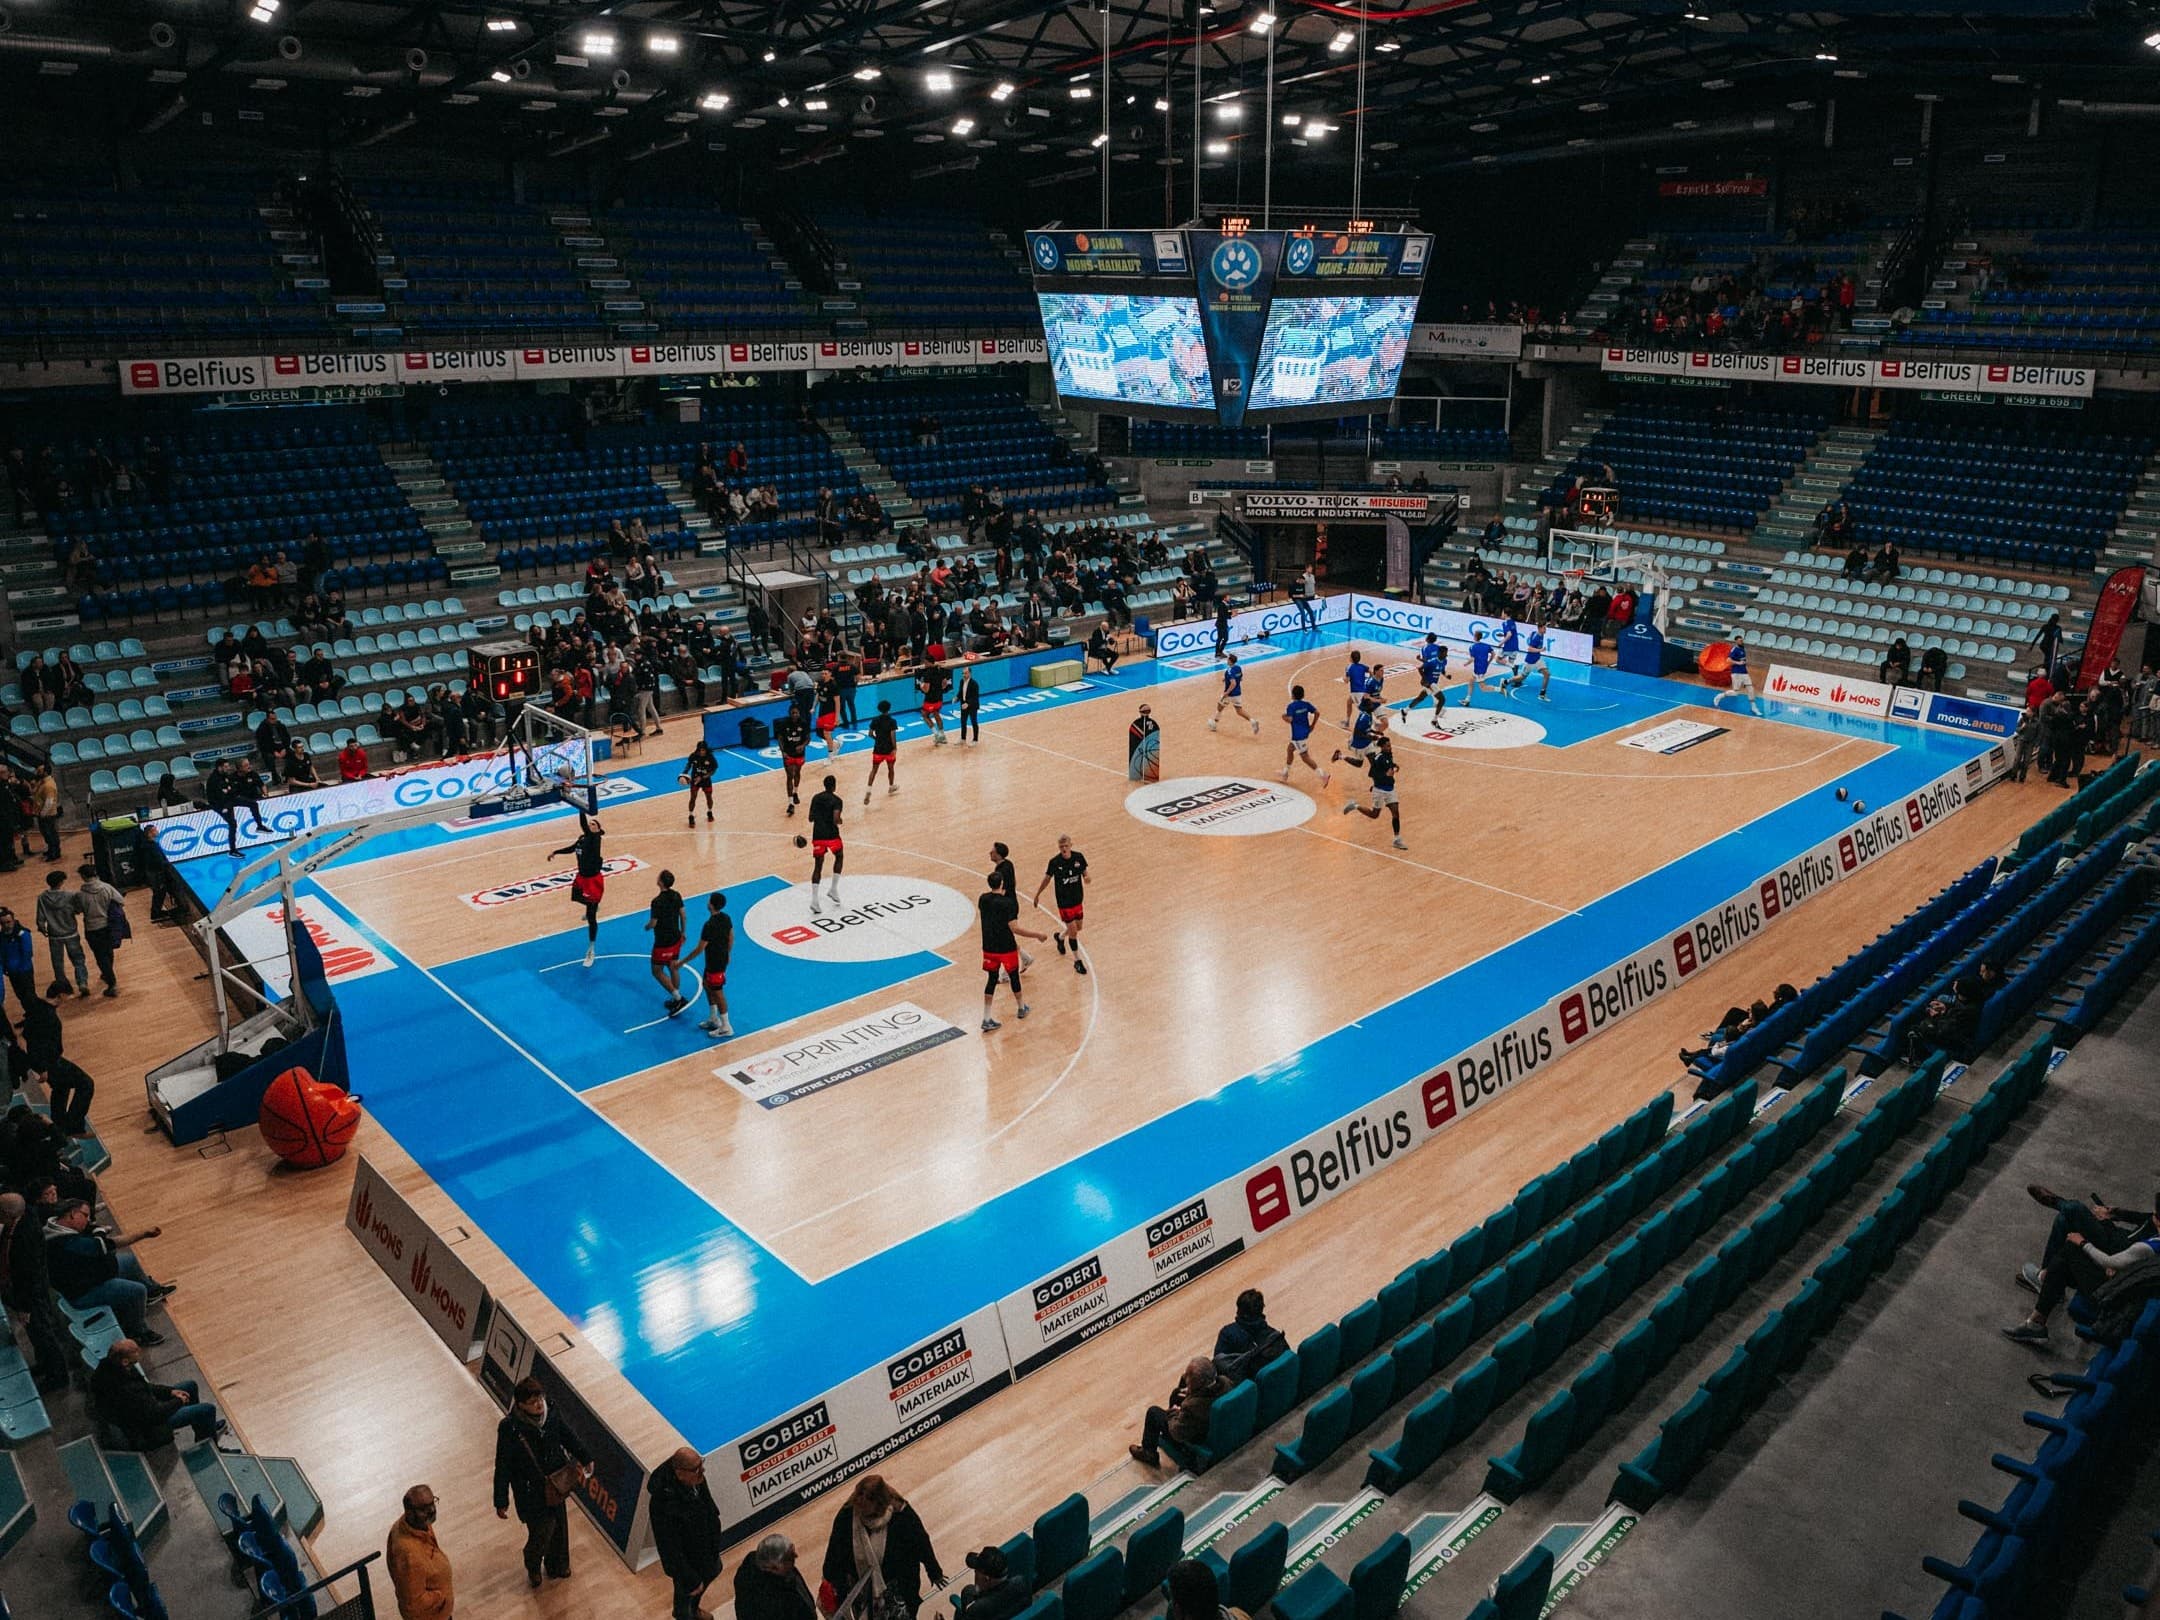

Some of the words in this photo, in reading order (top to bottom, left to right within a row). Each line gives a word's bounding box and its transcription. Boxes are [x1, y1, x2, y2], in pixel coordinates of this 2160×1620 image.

[1090, 237, 1124, 250] UNION
[1350, 240, 1380, 253] UNION
[654, 346, 716, 363] Belfius
[751, 344, 808, 362] Belfius
[922, 340, 971, 355] Belfius
[998, 339, 1043, 353] Belfius
[1711, 353, 1769, 370] Belfius
[164, 361, 255, 387] Belfius
[304, 354, 386, 374] Belfius
[1804, 358, 1866, 377] Belfius
[1904, 361, 1972, 380] Belfius
[2012, 365, 2086, 386] Belfius
[249, 389, 300, 401] GREEN
[1941, 391, 1981, 402] GREEN
[1191, 493, 1199, 502] B
[1250, 496, 1307, 507] VOLVO
[1318, 496, 1359, 507] TRUCK
[1369, 497, 1427, 509] MITSUBISHI
[1459, 494, 1468, 506] C
[1246, 509, 1277, 517] MONS
[1280, 509, 1315, 518] TRUCK
[1318, 509, 1371, 519] INDUSTRY
[1355, 600, 1433, 630] Gocar
[1789, 683, 1820, 696] MONS
[1849, 694, 1881, 707] MONS
[1936, 712, 2006, 733] mons.arena
[1156, 784, 1249, 815] GOBERT
[1919, 782, 1961, 825] Belfius
[1854, 815, 1903, 862] Belfius
[1780, 855, 1834, 907] Belfius
[811, 895, 932, 933] Belfius
[1696, 903, 1759, 963] Belfius
[1588, 958, 1667, 1028] Belfius
[783, 1011, 922, 1066] PRINTING
[790, 1078, 825, 1097] VOTRE
[823, 1069, 852, 1084] LOGO
[1457, 1027, 1552, 1108] Belfius
[1290, 1110, 1411, 1207] Belfius
[371, 1215, 404, 1260] MONS
[1149, 1203, 1204, 1242] GOBERT
[1156, 1234, 1212, 1272] MATERIAUX
[1036, 1261, 1097, 1304] GOBERT
[430, 1279, 467, 1330] MONS
[1043, 1293, 1105, 1336] MATERIAUX
[1080, 1272, 1189, 1339] www.groupegobert.com
[892, 1334, 961, 1381] GOBERT
[900, 1368, 970, 1416] MATERIAUX
[744, 1408, 824, 1460] GOBERT
[751, 1444, 834, 1498] MATERIAUX
[800, 1413, 941, 1500] www.groupegobert.com
[1312, 1545, 1326, 1557] VIP
[1335, 1526, 1349, 1539] VIP
[1416, 1572, 1433, 1585] 162
[1430, 1558, 1445, 1572] VIP
[1452, 1538, 1467, 1551] VIP
[1484, 1509, 1499, 1522] 132
[1553, 1586, 1569, 1601] 166
[1566, 1572, 1581, 1586] VIP
[1588, 1550, 1603, 1564] VIP
[1602, 1536, 1617, 1551] 133
